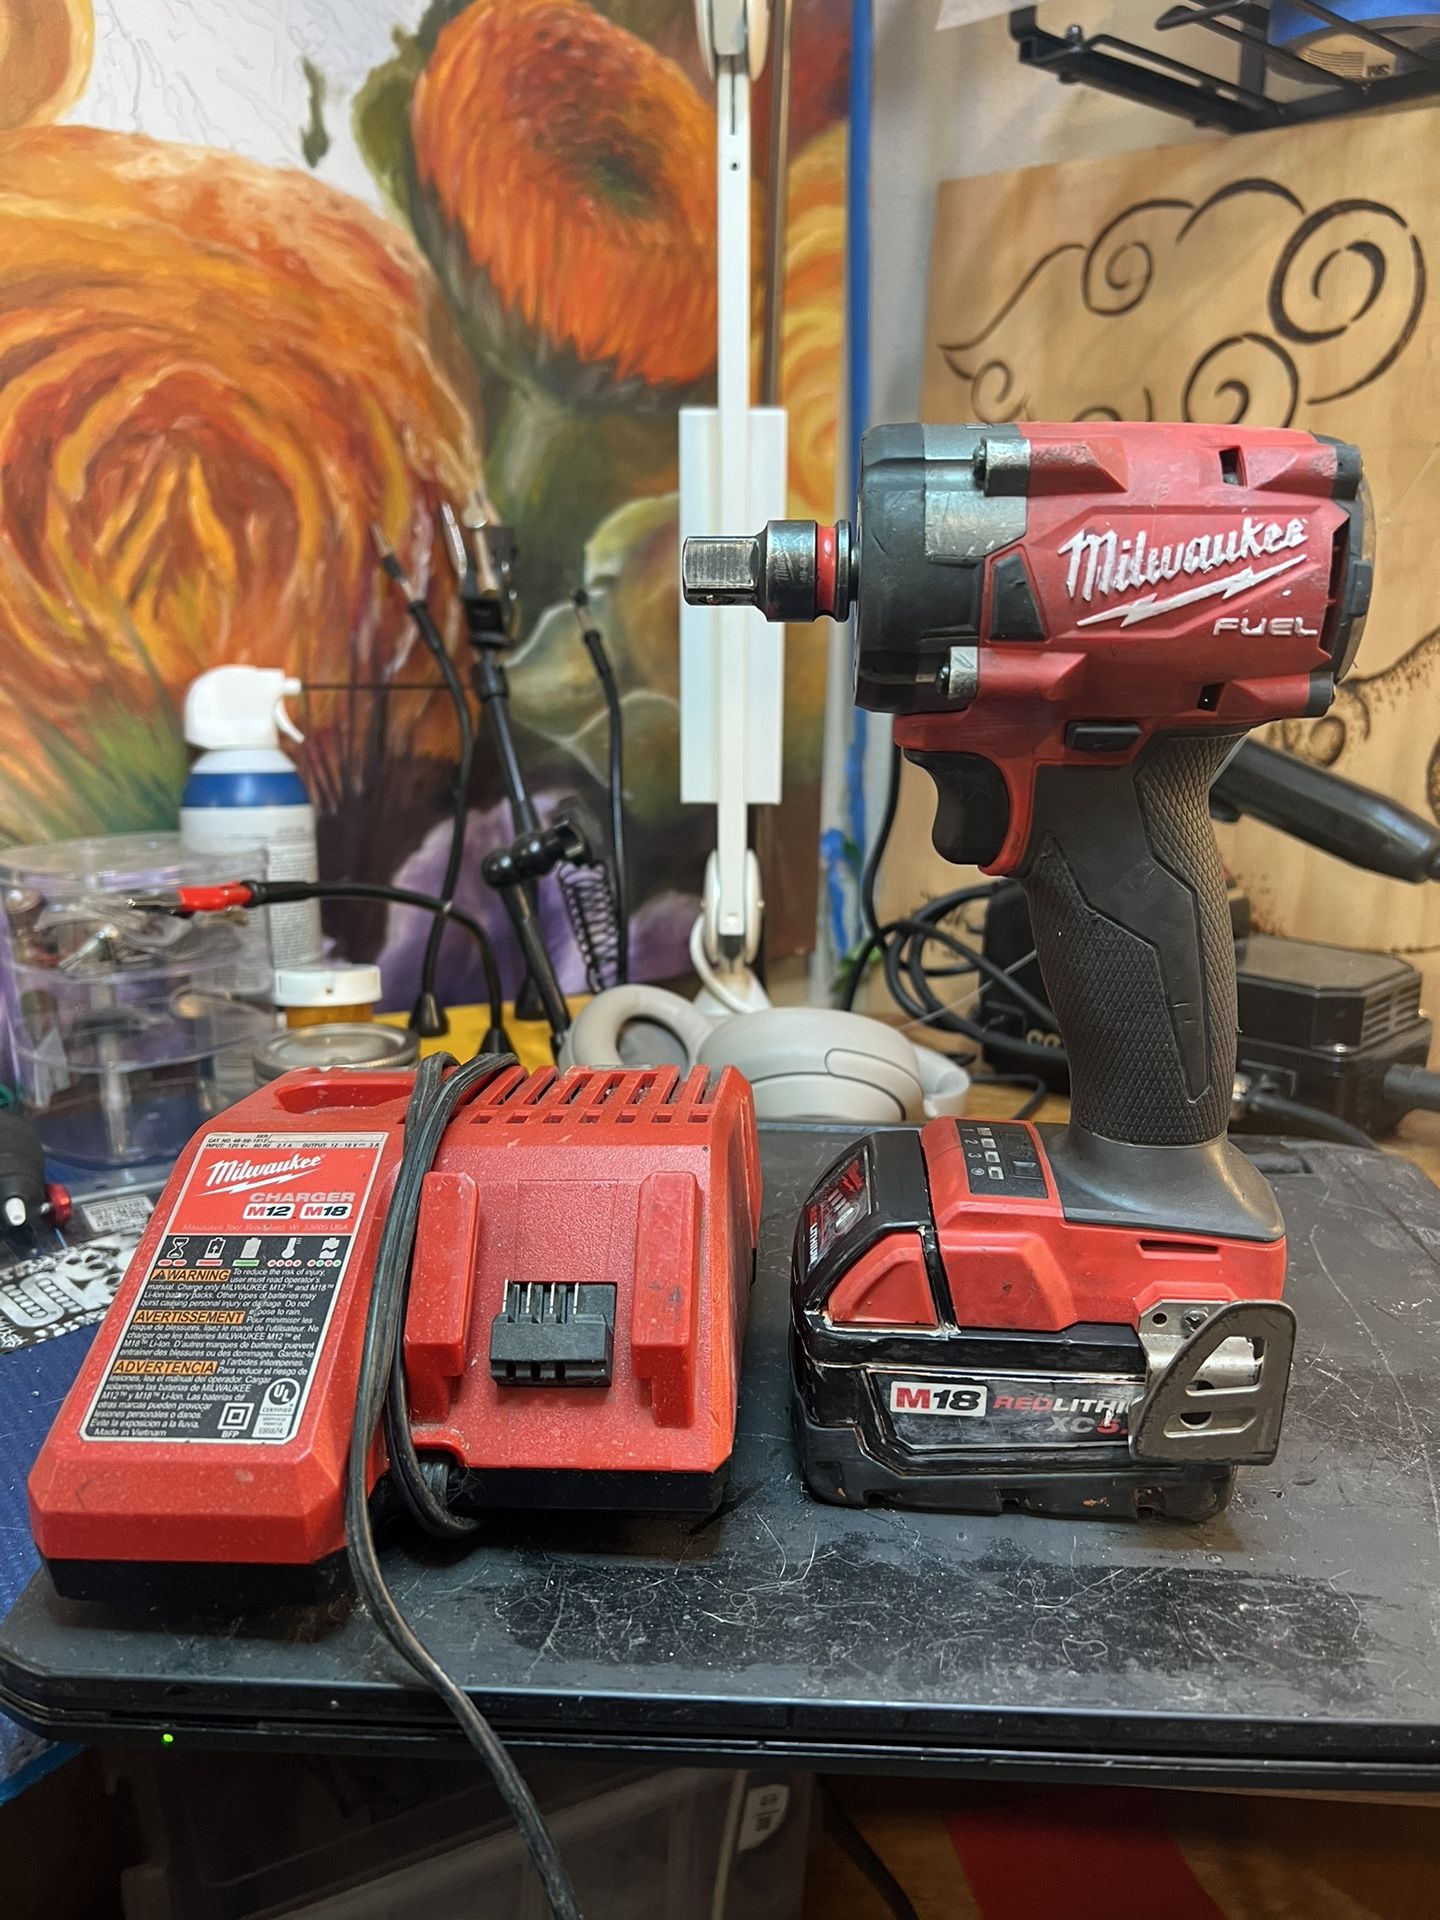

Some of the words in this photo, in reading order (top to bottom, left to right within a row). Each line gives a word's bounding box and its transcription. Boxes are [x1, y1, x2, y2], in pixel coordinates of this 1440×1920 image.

[1057, 517, 1309, 601] Milwaukee
[1213, 616, 1318, 636] FUEL
[206, 1153, 322, 1187] Milwaukee
[250, 1192, 356, 1203] CHARGER
[246, 1206, 291, 1217] M12
[304, 1206, 349, 1217] M18
[168, 1270, 229, 1280] WARNING
[204, 1284, 220, 1292] only
[135, 1311, 244, 1322] AVERTISSEMENT
[114, 1361, 215, 1373] ADVERTENCIA
[201, 1384, 252, 1392] MILWAUKEE
[896, 1387, 981, 1411] M18
[993, 1395, 1129, 1414] REDLITHI
[221, 1430, 240, 1438] BFP
